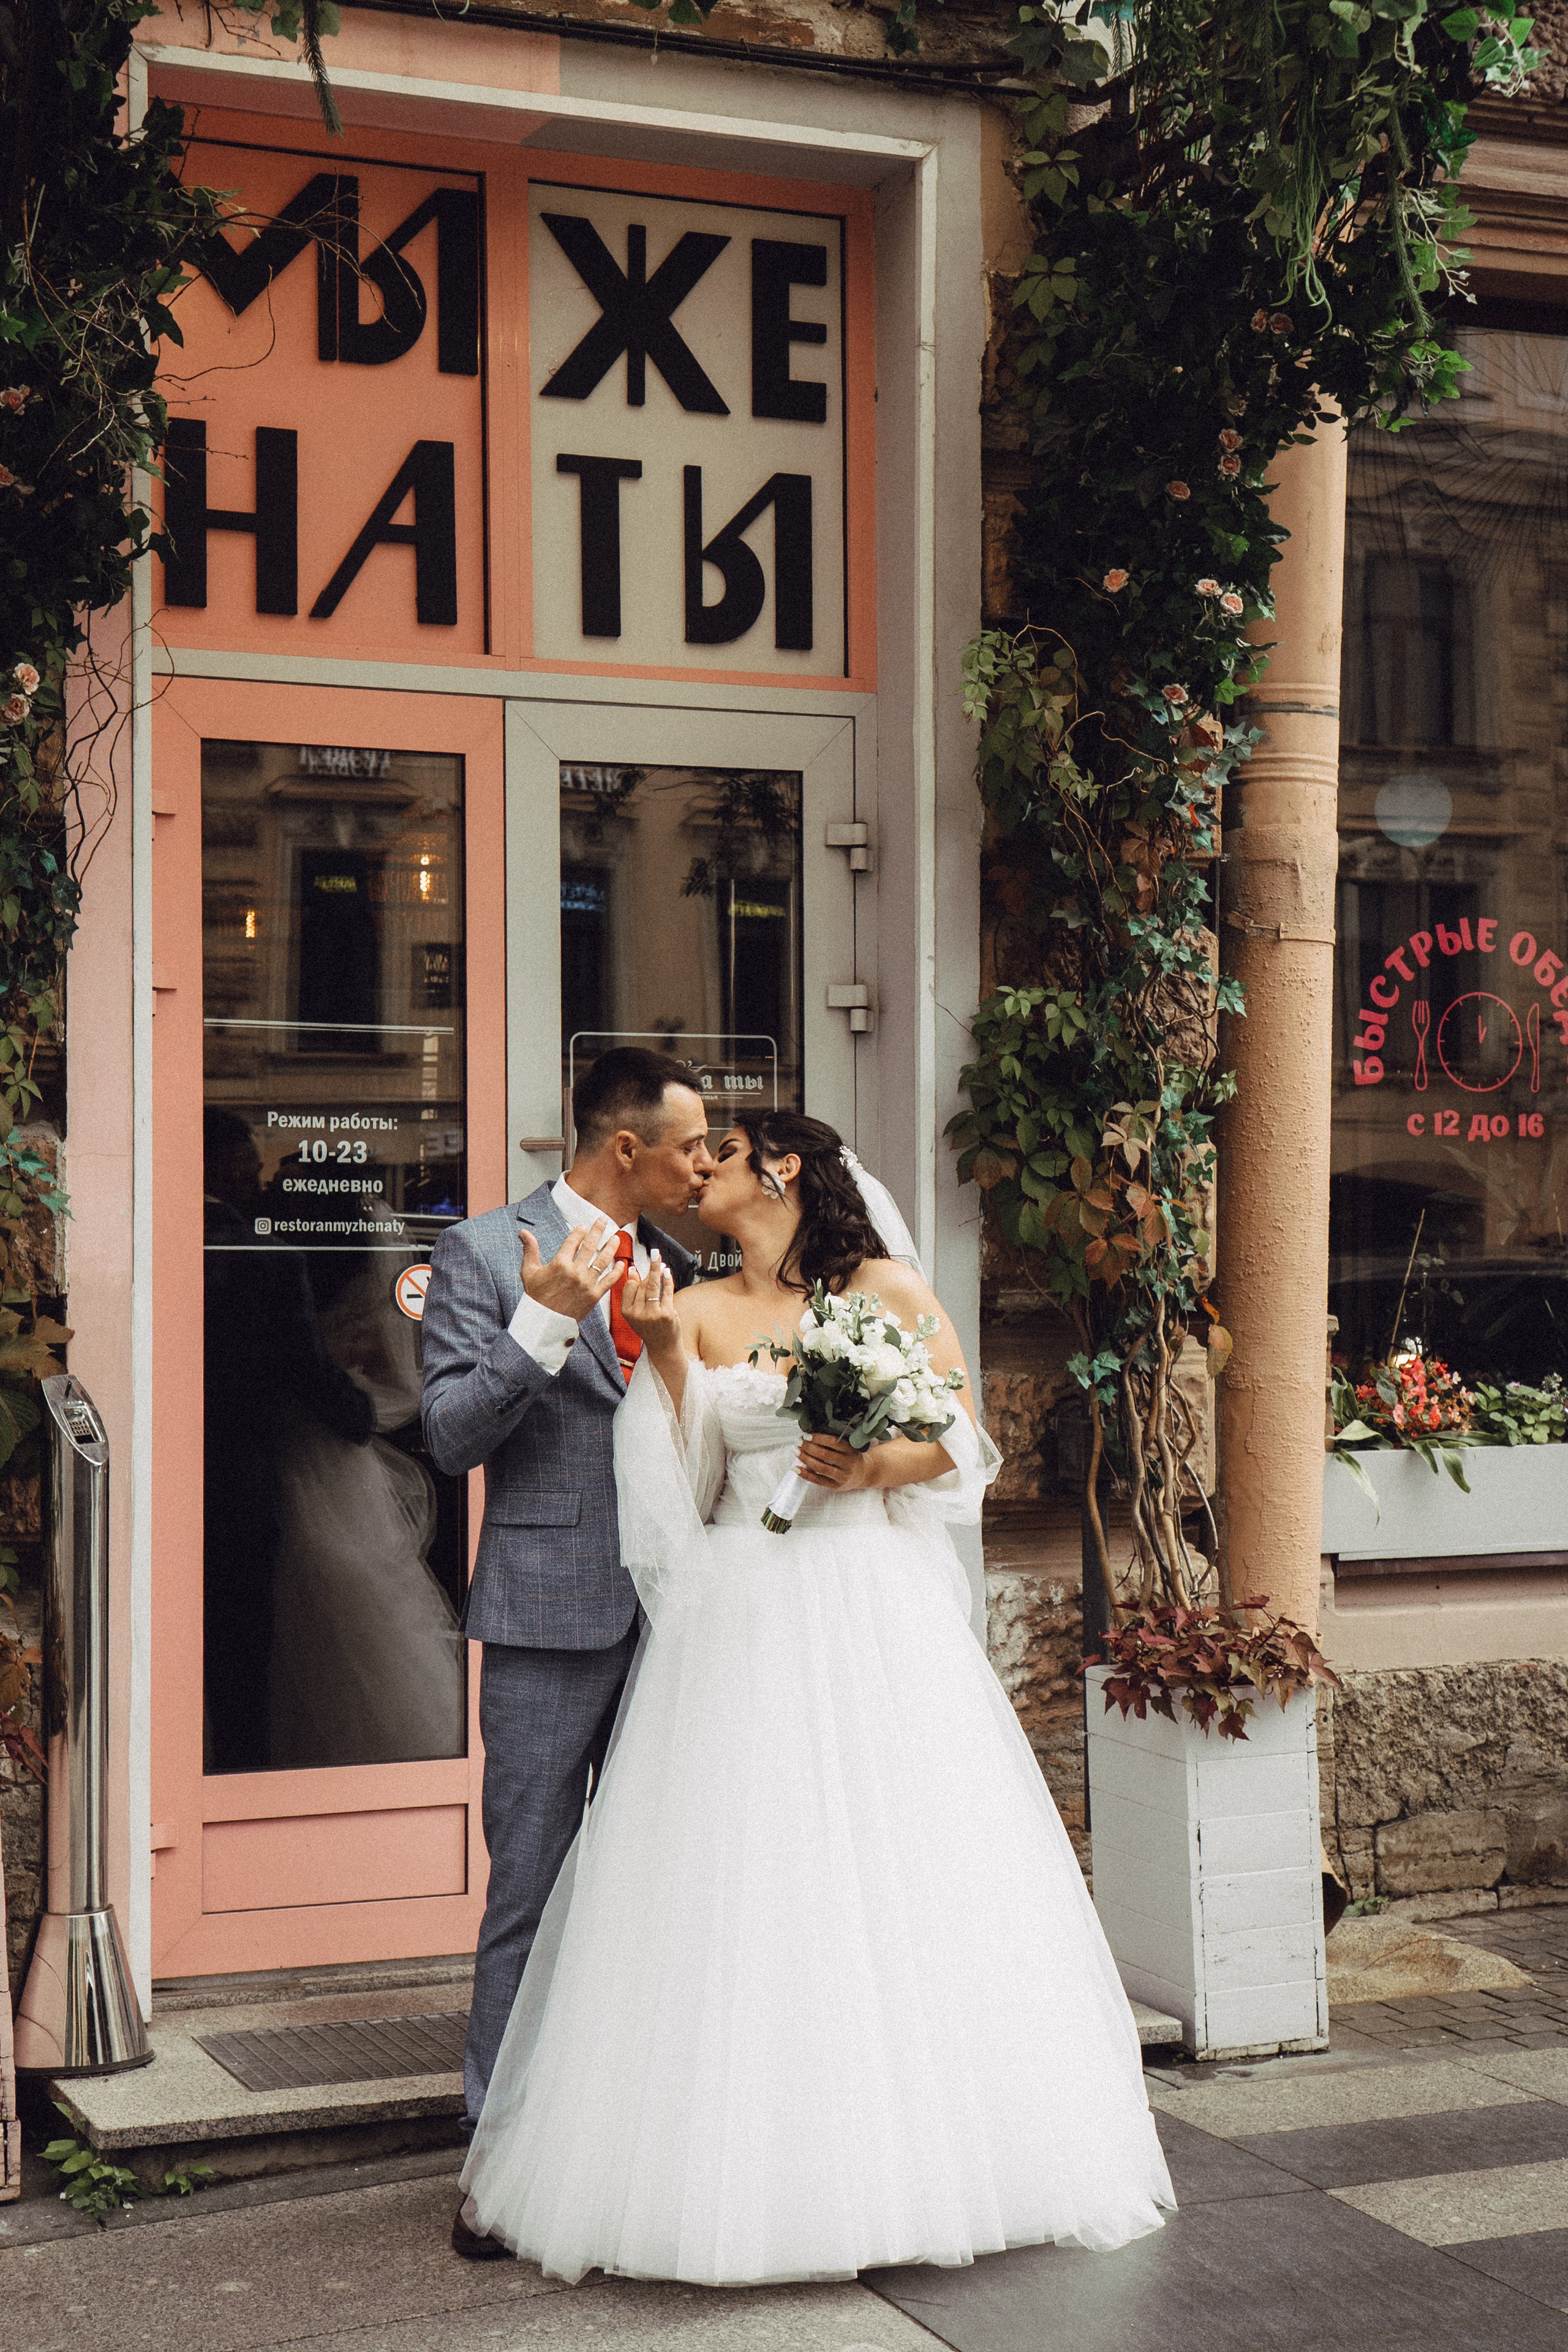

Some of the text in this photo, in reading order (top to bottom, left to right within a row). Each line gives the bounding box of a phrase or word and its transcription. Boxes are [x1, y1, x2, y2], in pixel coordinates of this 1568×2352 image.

[540, 212, 827, 423] ЖЕ
[165, 417, 812, 650] НА ТЫ
[1353, 918, 1568, 1085] БЫСТРЫЕ ОБЕ
[268, 1111, 398, 1132] Режим работы:
[1434, 1110, 1460, 1136] 12
[1518, 1114, 1545, 1138] 16
[298, 1140, 368, 1163] 10-23
[283, 1178, 383, 1194] ежедневно
[274, 1218, 405, 1235] restoranmyzhenaty
